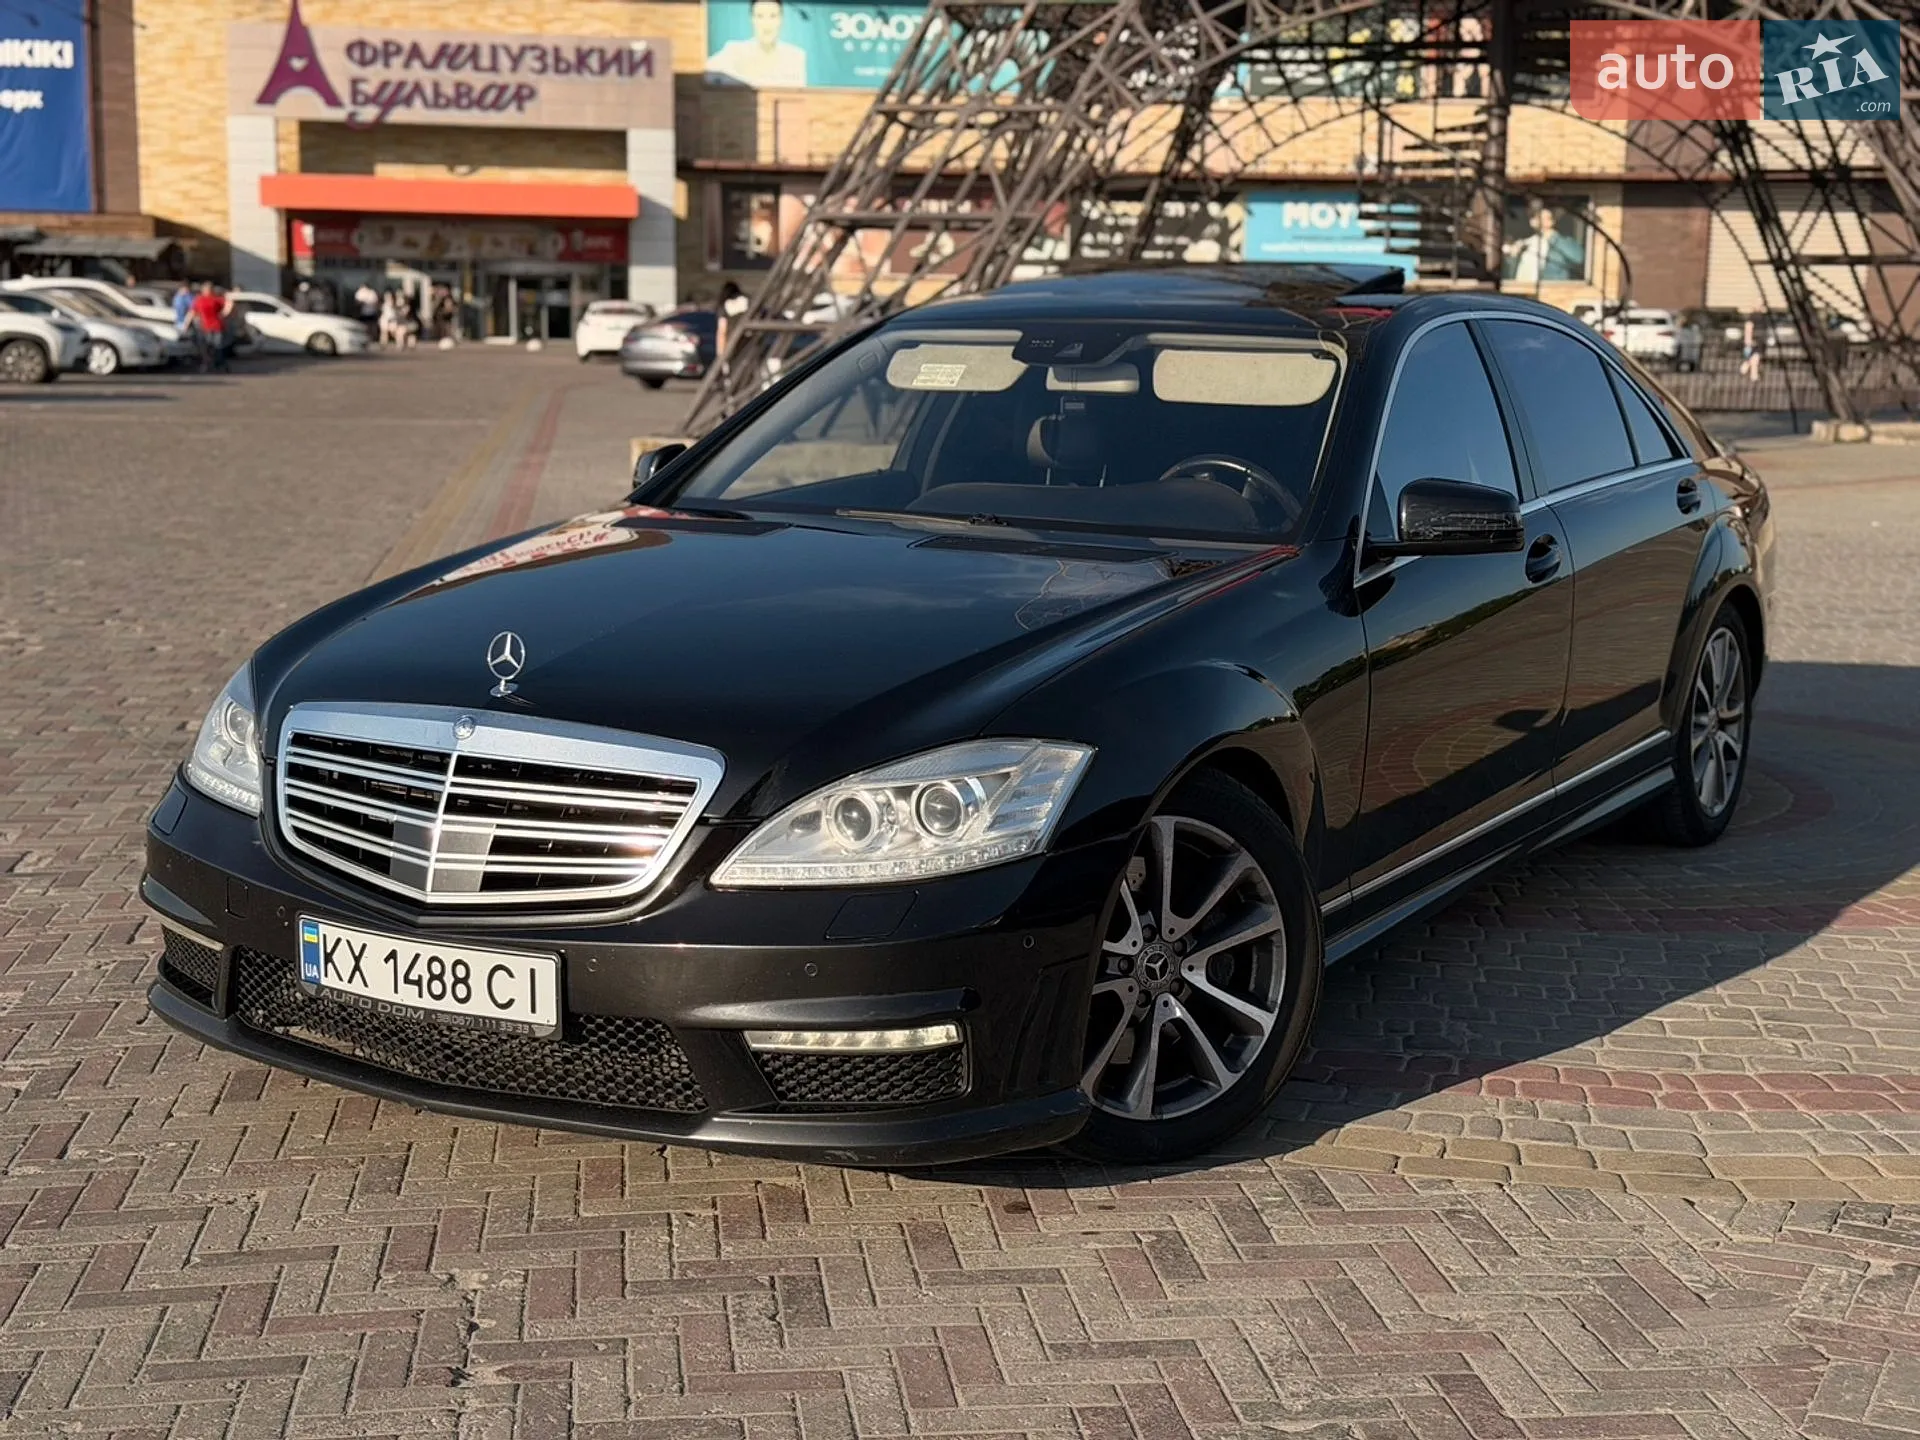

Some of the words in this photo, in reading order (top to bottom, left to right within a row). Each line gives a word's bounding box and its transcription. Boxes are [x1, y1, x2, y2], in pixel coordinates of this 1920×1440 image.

[345, 39, 655, 78] ФРАНЦУЗЬКИЙ
[305, 962, 320, 980] UA
[322, 933, 369, 988] KX
[384, 948, 472, 1005] 1488
[486, 963, 537, 1015] CI
[319, 987, 373, 1009] AUTO
[376, 1002, 425, 1021] DOM
